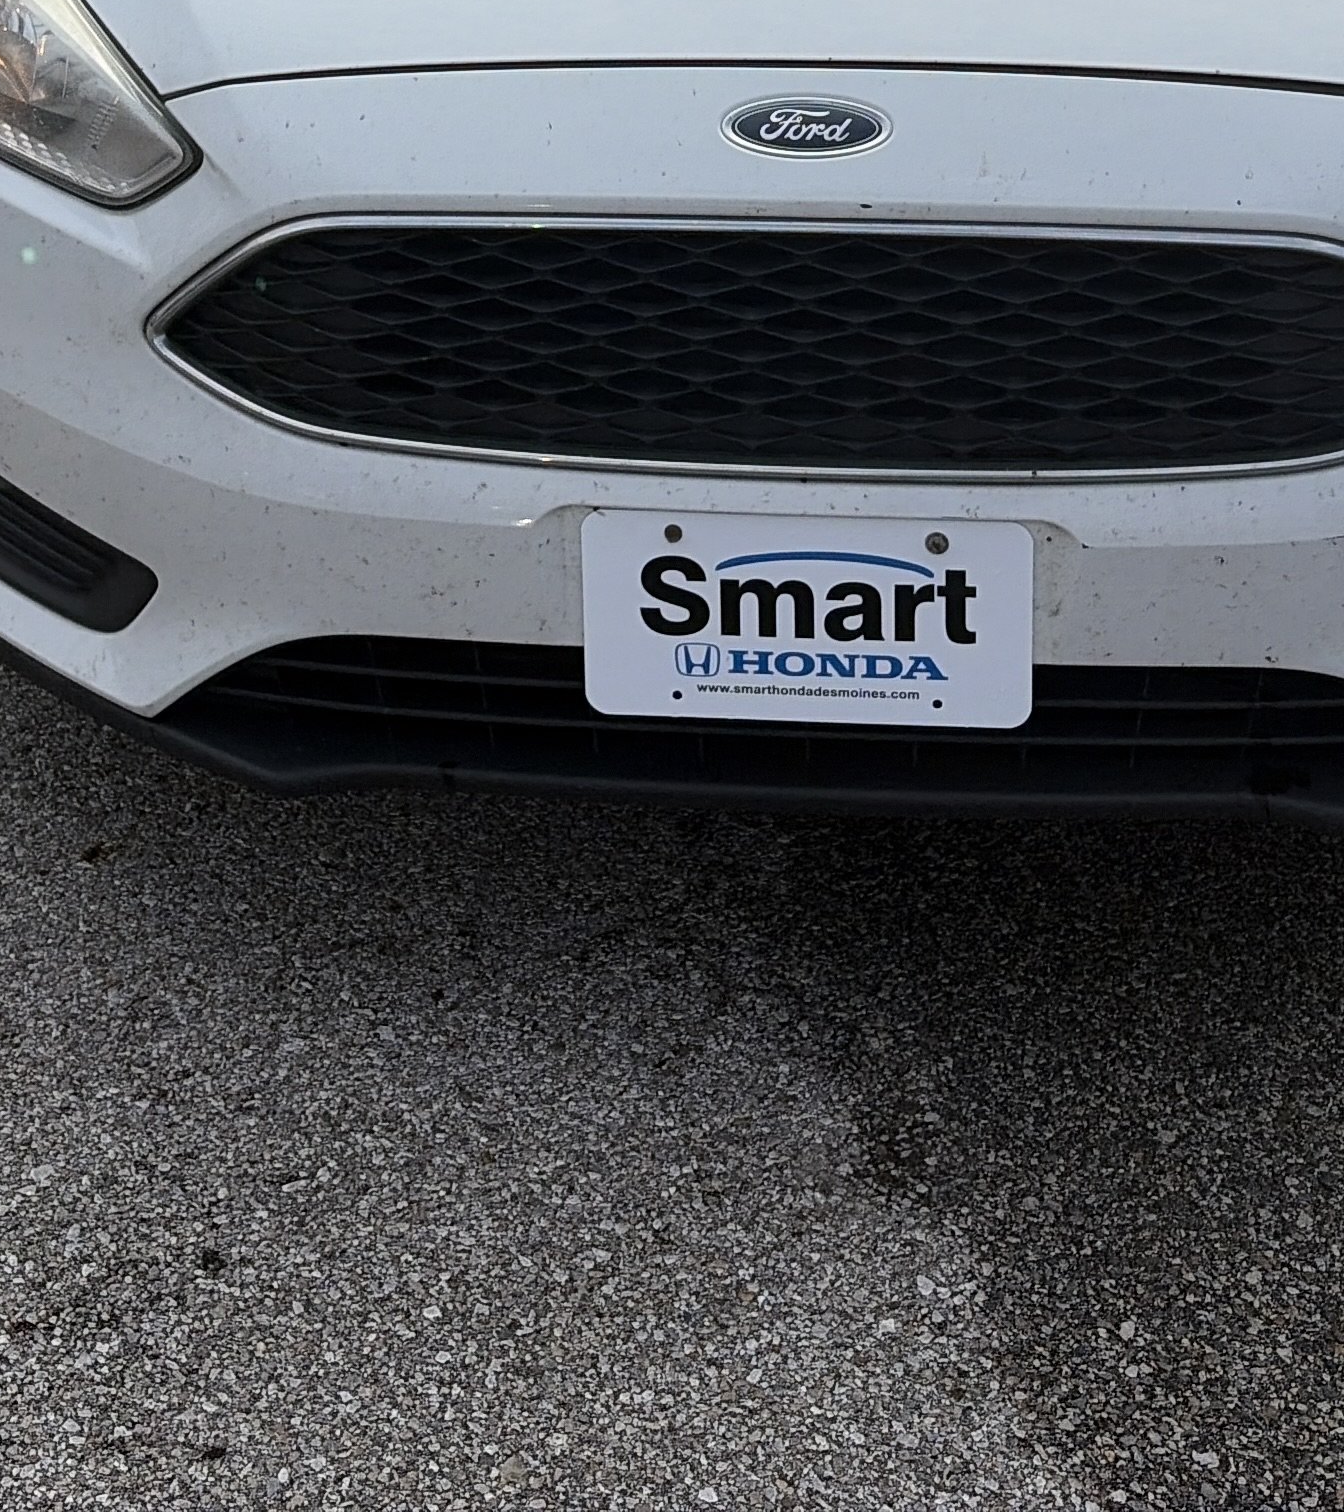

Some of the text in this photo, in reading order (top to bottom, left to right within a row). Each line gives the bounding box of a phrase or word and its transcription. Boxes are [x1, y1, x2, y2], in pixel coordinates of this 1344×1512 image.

[759, 108, 853, 142] Ford
[639, 554, 977, 645] Smart
[727, 649, 949, 681] HONDA
[696, 682, 921, 701] www.smarthondadesmoines.com
